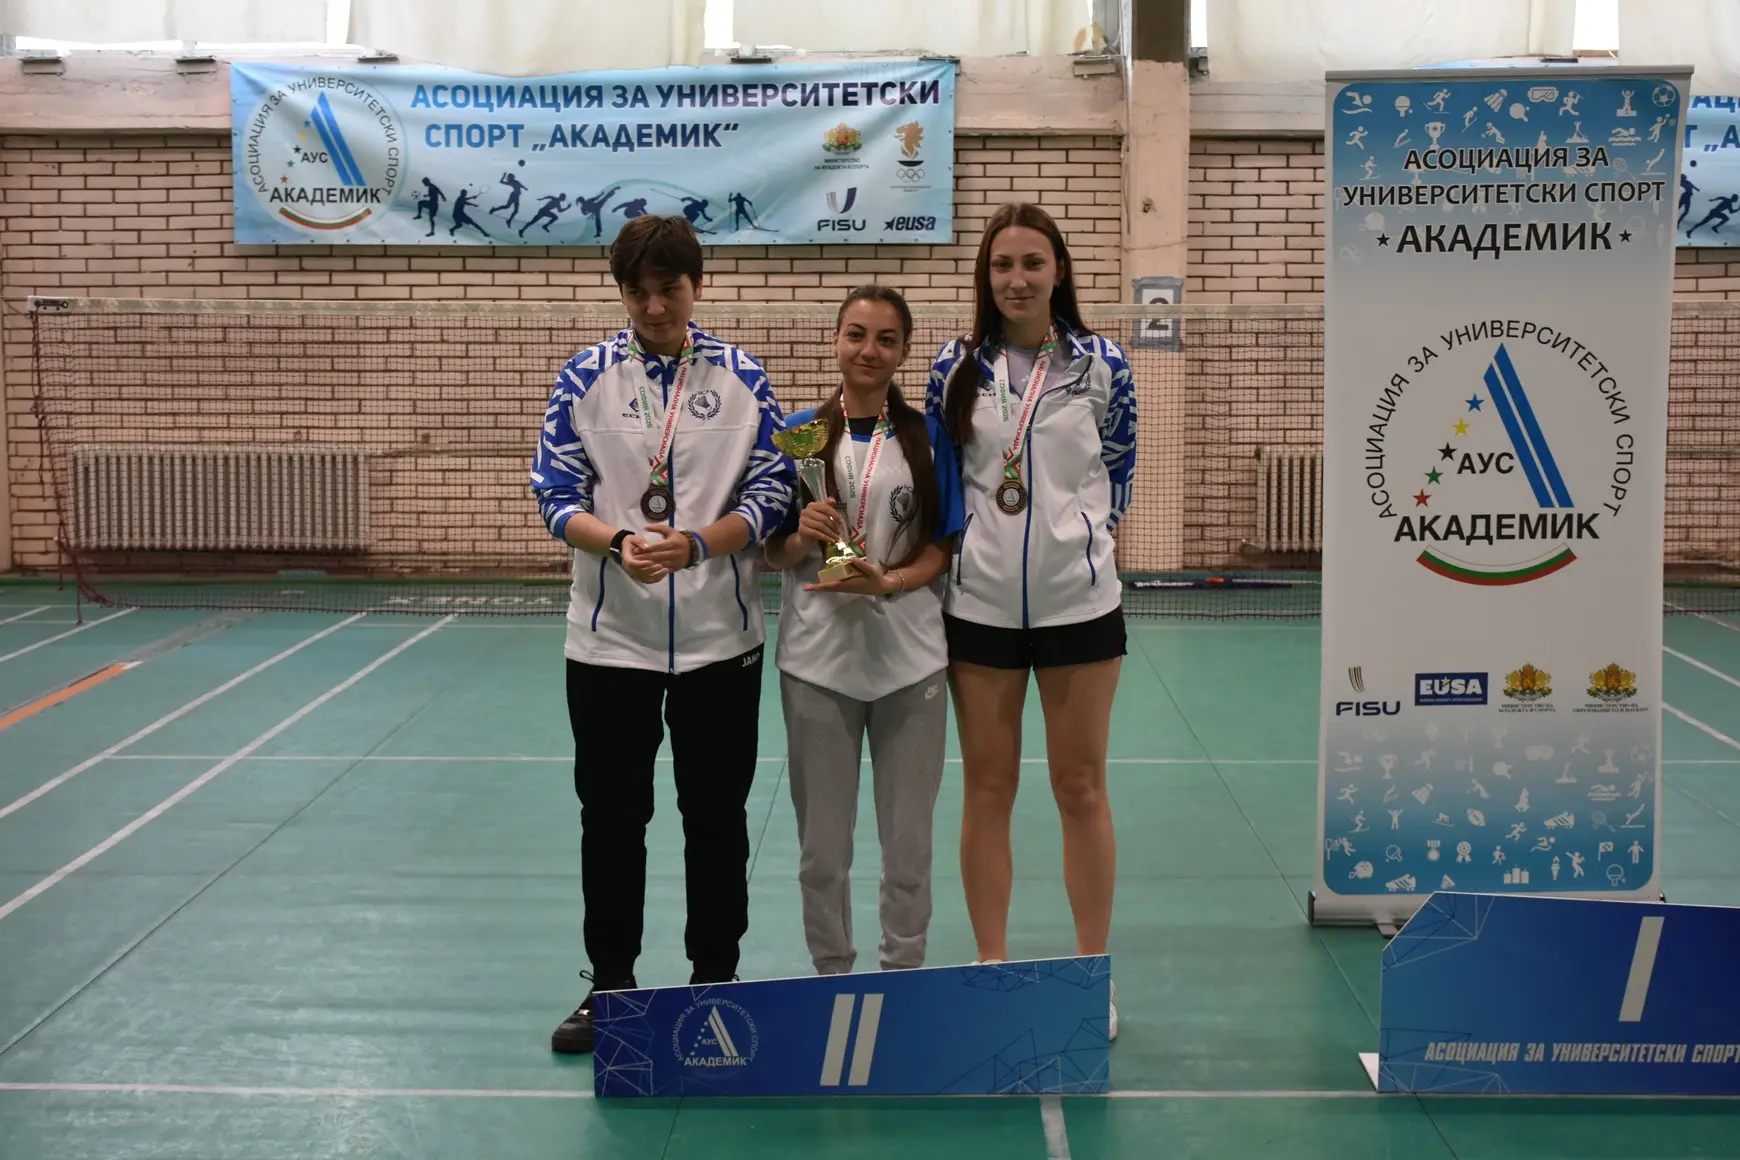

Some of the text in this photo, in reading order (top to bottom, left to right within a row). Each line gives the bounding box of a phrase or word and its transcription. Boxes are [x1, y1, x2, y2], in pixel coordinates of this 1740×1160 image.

[410, 80, 940, 112] АСОЦИАЦИЯ ЗА УНИВЕРСИТЕТСКИ
[248, 77, 399, 196] АСОЦИАЦИЯ ЗА УНИВЕРСИТЕТСКИ СПОРТ
[424, 122, 739, 152] СПОРТ „АКАДЕМИК“
[301, 152, 329, 164] АУС
[1403, 146, 1609, 173] АСОЦИАЦИЯ ЗА
[269, 187, 381, 206] АКАДЕМИК
[1342, 181, 1666, 207] УНИВЕРСИТЕТСКИ СПОРТ
[817, 219, 866, 232] FISU
[895, 216, 937, 231] eusa
[1395, 222, 1613, 261] АКАДЕМИК
[1365, 320, 1634, 519] АСОЦИАЦИЯ ЗА УНИВЕРСИТЕТСКИ СПОРТ
[1456, 452, 1515, 475] АУС
[1393, 513, 1600, 546] АКАДЕМИК
[1420, 678, 1483, 696] EUSA
[1335, 701, 1401, 717] FISU
[684, 1057, 748, 1068] АКАДЕМИК
[1424, 1041, 1520, 1065] АСОЦИАЦИЯ
[1524, 1043, 1545, 1062] ЗА
[1551, 1042, 1686, 1063] УНИВЕРСИТЕТСКИ
